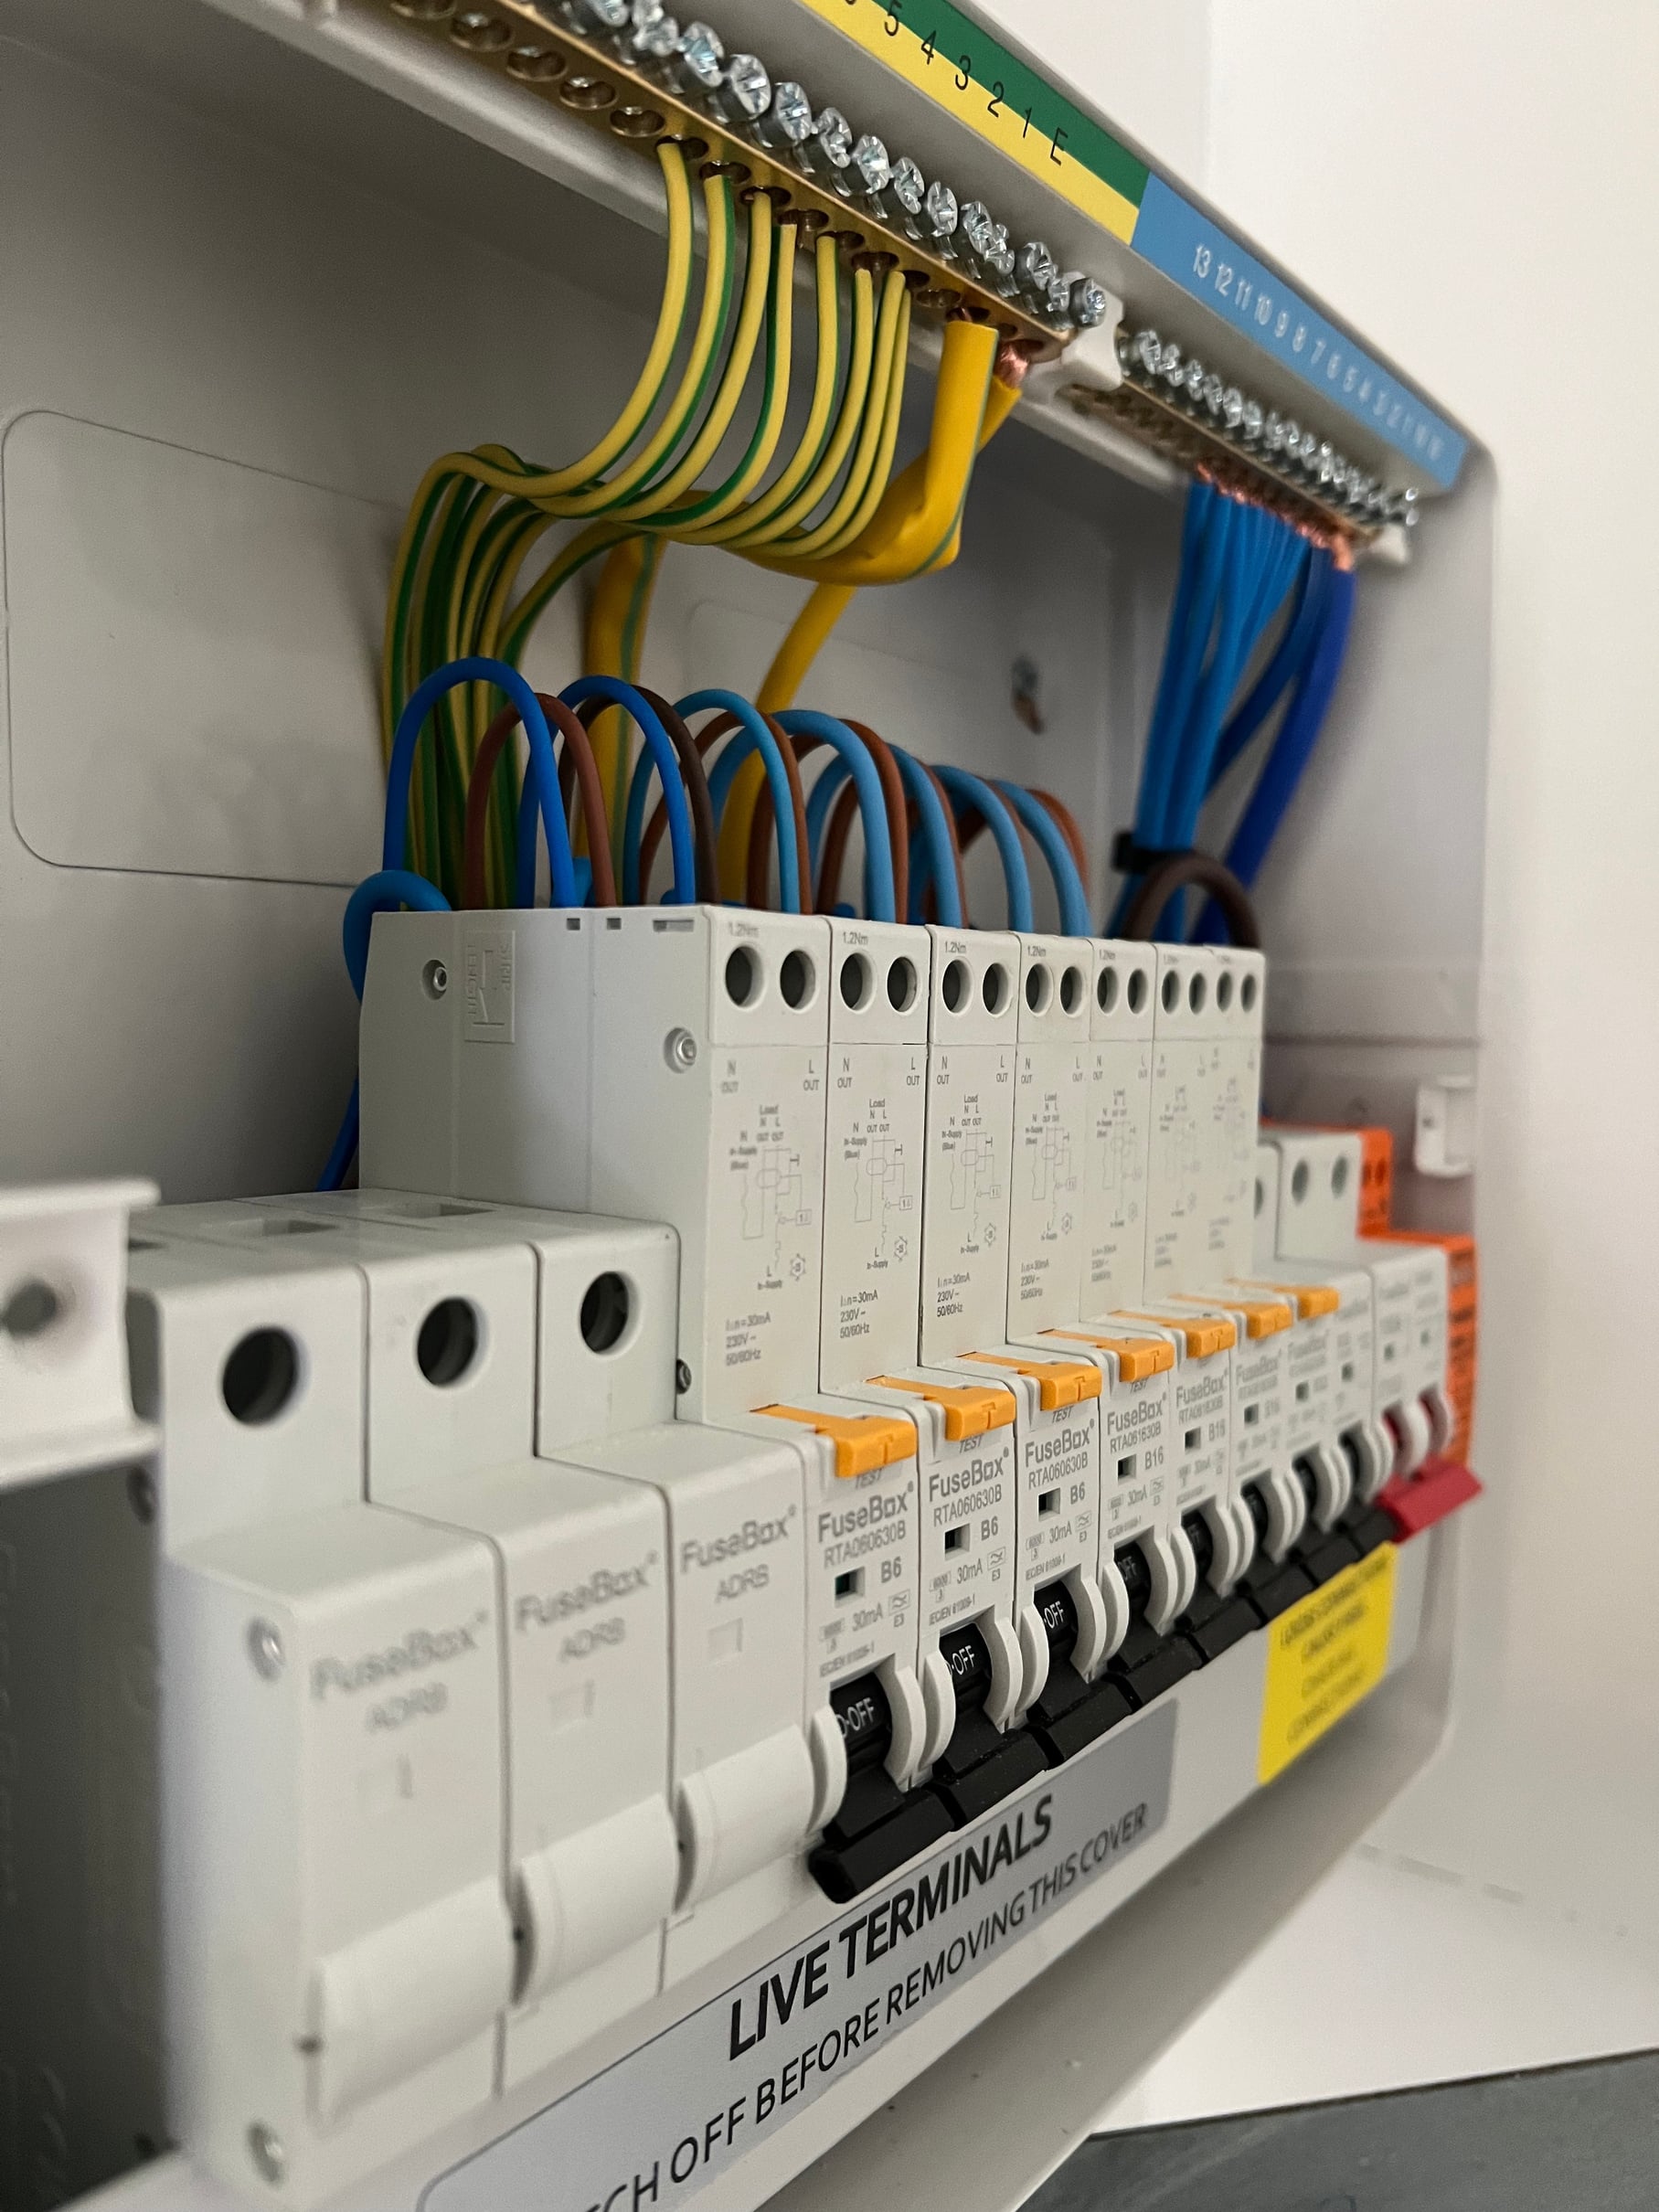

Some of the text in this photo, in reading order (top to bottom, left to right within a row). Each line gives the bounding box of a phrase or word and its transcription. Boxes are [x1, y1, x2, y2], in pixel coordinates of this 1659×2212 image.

[885, 0, 1069, 165] 5 4 3 2 1 E
[1193, 243, 1211, 278] 13
[1215, 262, 1233, 296] 12
[1235, 279, 1251, 310] 11
[1254, 294, 1273, 325] 10
[842, 931, 868, 945] 1.2Nm
[944, 941, 967, 953] 1.2Nm
[843, 1058, 850, 1072] N
[941, 1056, 948, 1070] N
[1025, 1058, 1031, 1069] N
[803, 1079, 820, 1091] OUT
[837, 1075, 920, 1089] OUT OUT
[936, 1071, 1008, 1085] OUT OUT
[1021, 1074, 1033, 1084] OUT
[937, 1303, 963, 1317] 50/60Hz
[840, 1323, 870, 1339] 50/60Hz
[1051, 1405, 1074, 1424] TEST
[960, 1435, 984, 1454] TEST
[1144, 1446, 1164, 1471] B16
[1028, 1451, 1089, 1490] RTA060630B
[1070, 1482, 1086, 1505] B6
[933, 1484, 1003, 1527] RTA060630B
[981, 1515, 998, 1541] B6
[1048, 1520, 1072, 1544] 30mA
[880, 1556, 902, 1583] B6
[957, 1558, 984, 1584] 30mA
[852, 1601, 883, 1632] 30mA
[729, 1793, 1053, 2061] LIVE TERMINALS
[671, 2096, 747, 2184] OFF
[756, 1998, 879, 2124] BEFORE
[886, 1890, 1025, 2025] REMOVING
[1029, 1856, 1078, 1904] THIS
[1080, 1803, 1148, 1872] COVER
